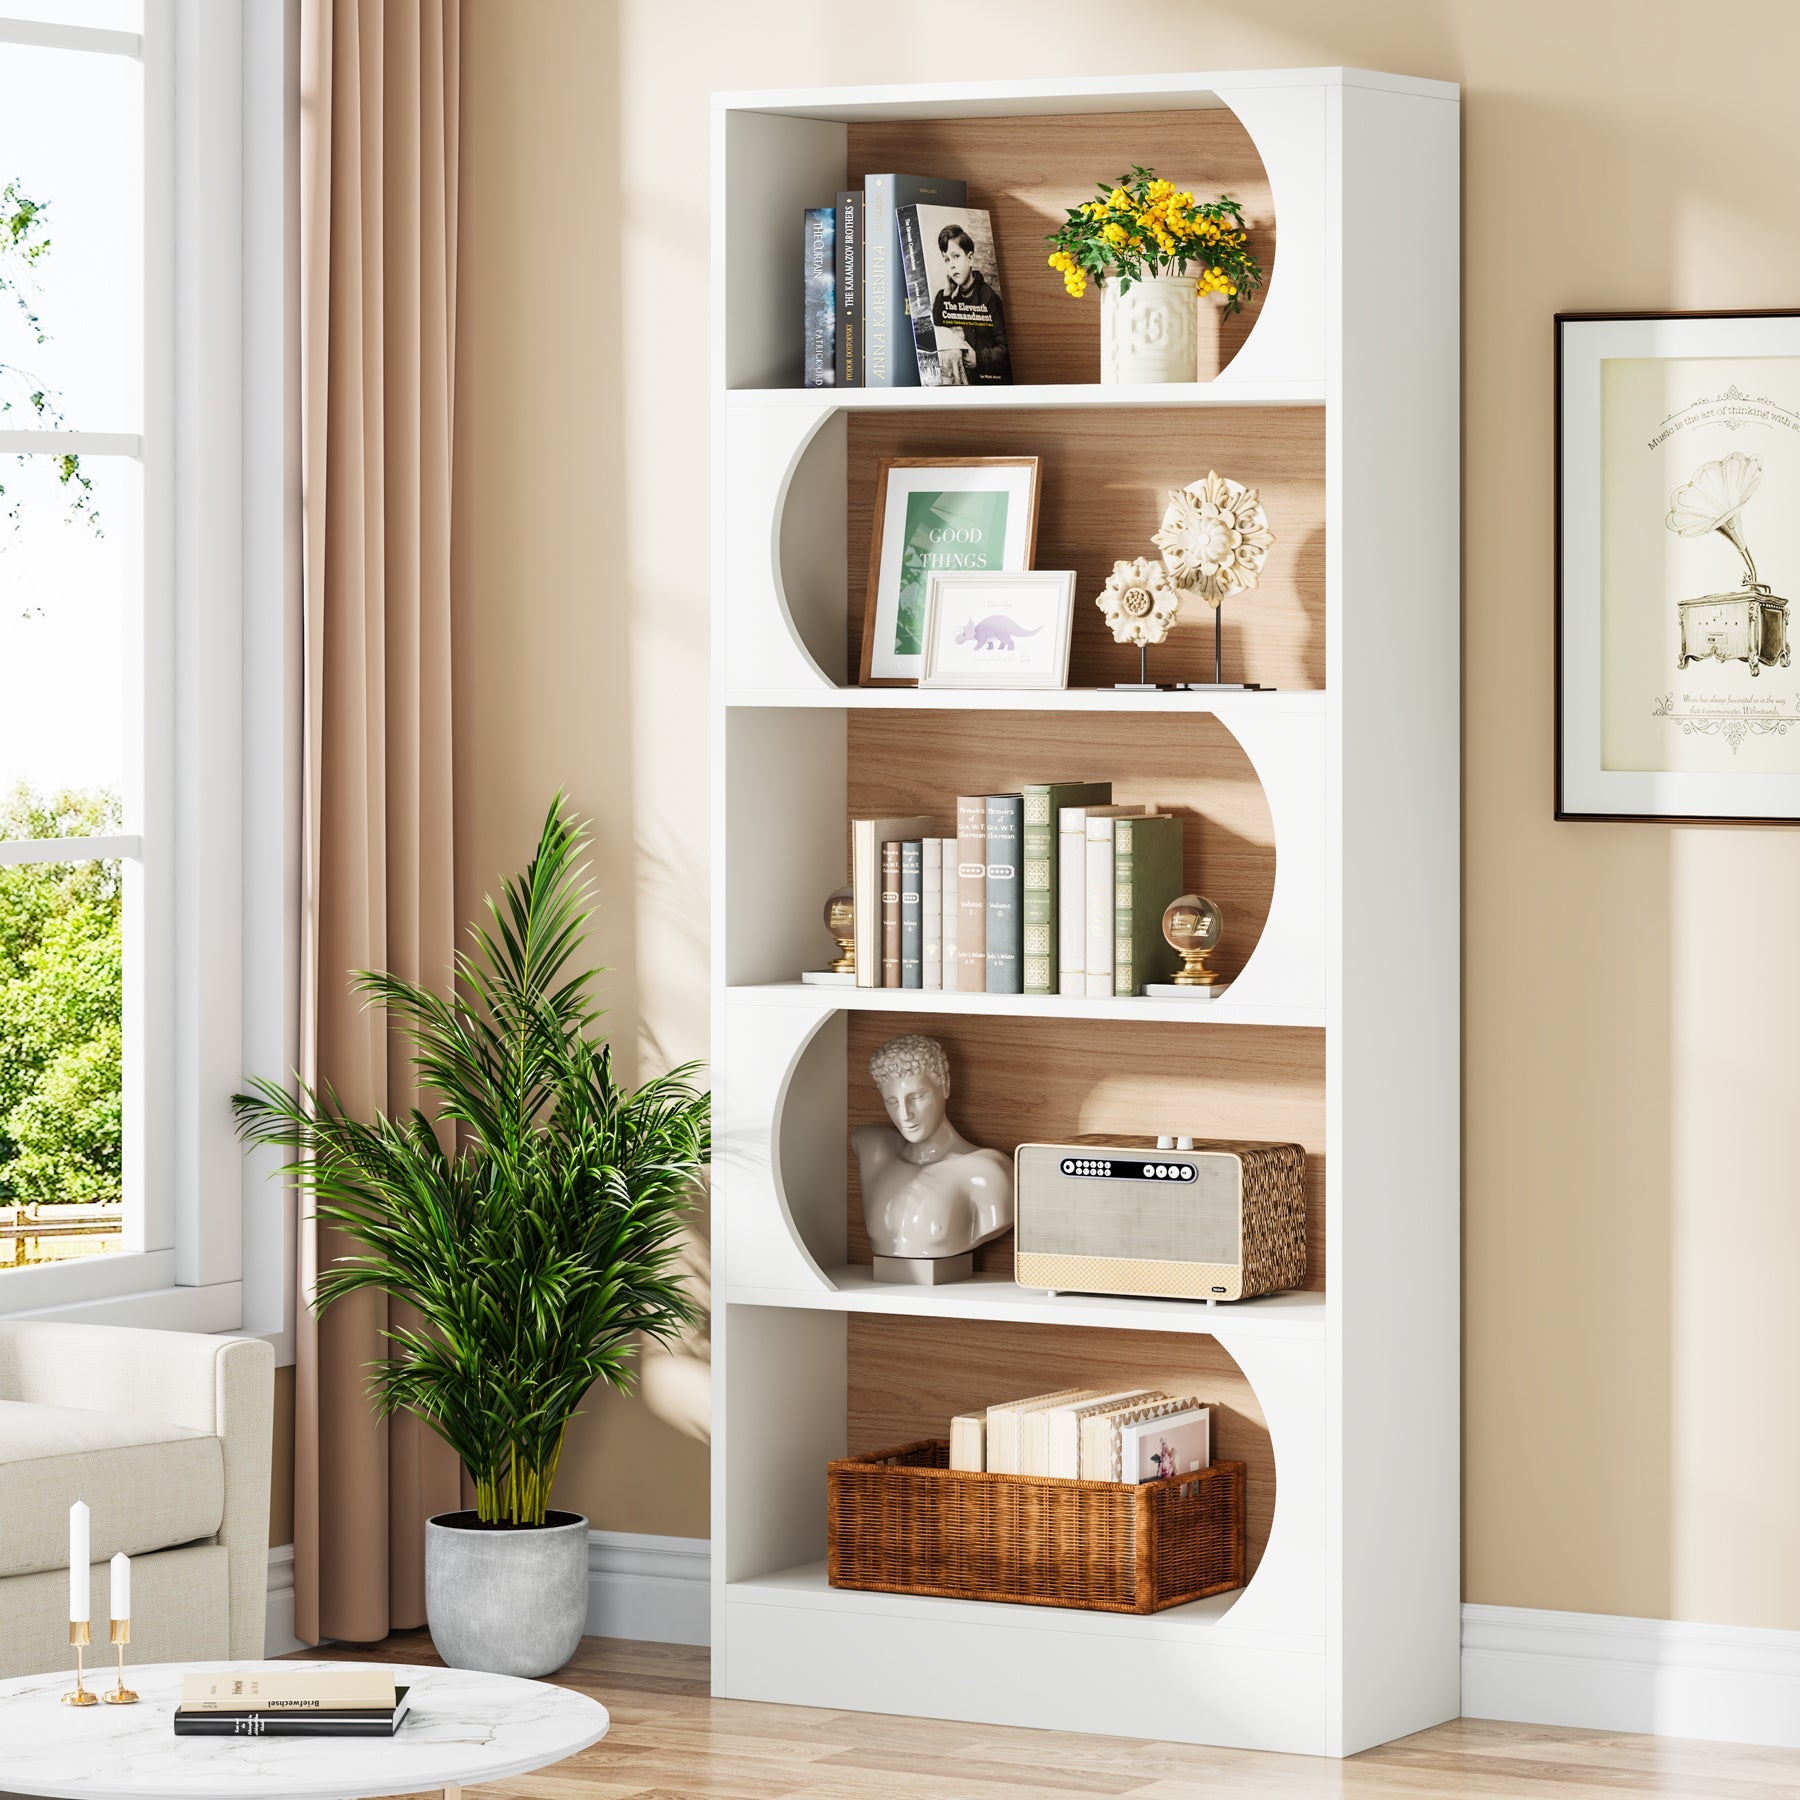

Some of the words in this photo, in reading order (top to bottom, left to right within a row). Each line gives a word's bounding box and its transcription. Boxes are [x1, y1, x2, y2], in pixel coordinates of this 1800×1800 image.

[814, 221, 823, 239] THE
[845, 206, 854, 244] BROTHERS
[814, 240, 824, 279] CURTAIN
[845, 246, 854, 290] KARAMAZOV
[872, 245, 886, 328] KARENINA
[845, 292, 854, 308] THE
[944, 301, 957, 310] The
[958, 302, 988, 312] Eleventh
[942, 310, 992, 322] Commandment
[816, 330, 824, 364] PATRICK
[872, 333, 886, 380] ANNA
[815, 367, 824, 386] ORD
[1648, 427, 1674, 450] Music
[1675, 422, 1683, 430] is
[1684, 415, 1700, 425] the
[1701, 410, 1715, 418] art
[1717, 406, 1727, 415] of
[1728, 406, 1769, 420] thinking
[1771, 413, 1790, 427] with
[929, 528, 982, 543] GOOD
[920, 553, 987, 568] THINGS
